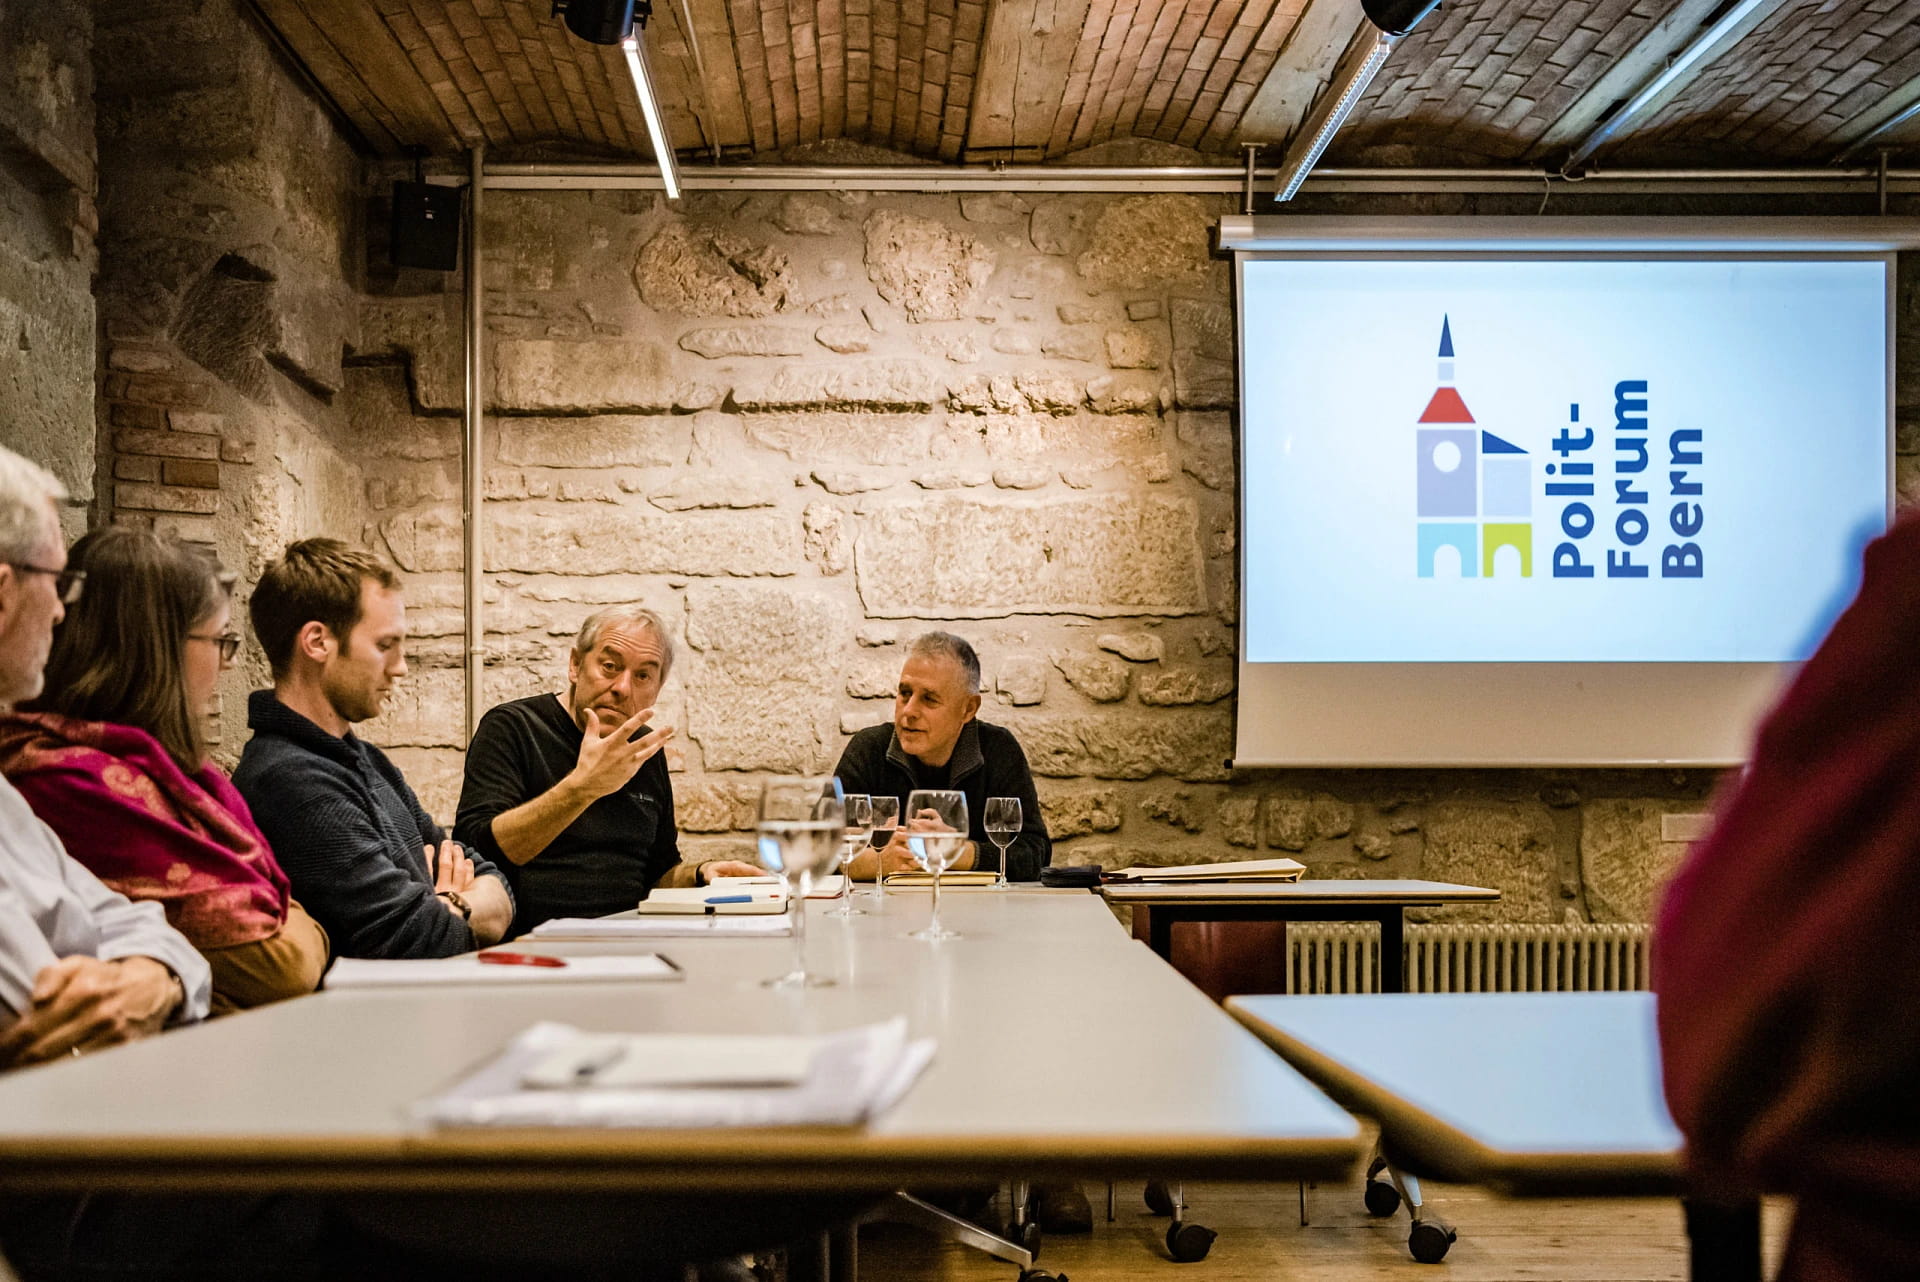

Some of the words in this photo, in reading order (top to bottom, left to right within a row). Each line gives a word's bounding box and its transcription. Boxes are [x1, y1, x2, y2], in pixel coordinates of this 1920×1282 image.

[1545, 403, 1595, 578] Polit-
[1607, 380, 1649, 578] Forum
[1661, 429, 1704, 578] Bern
